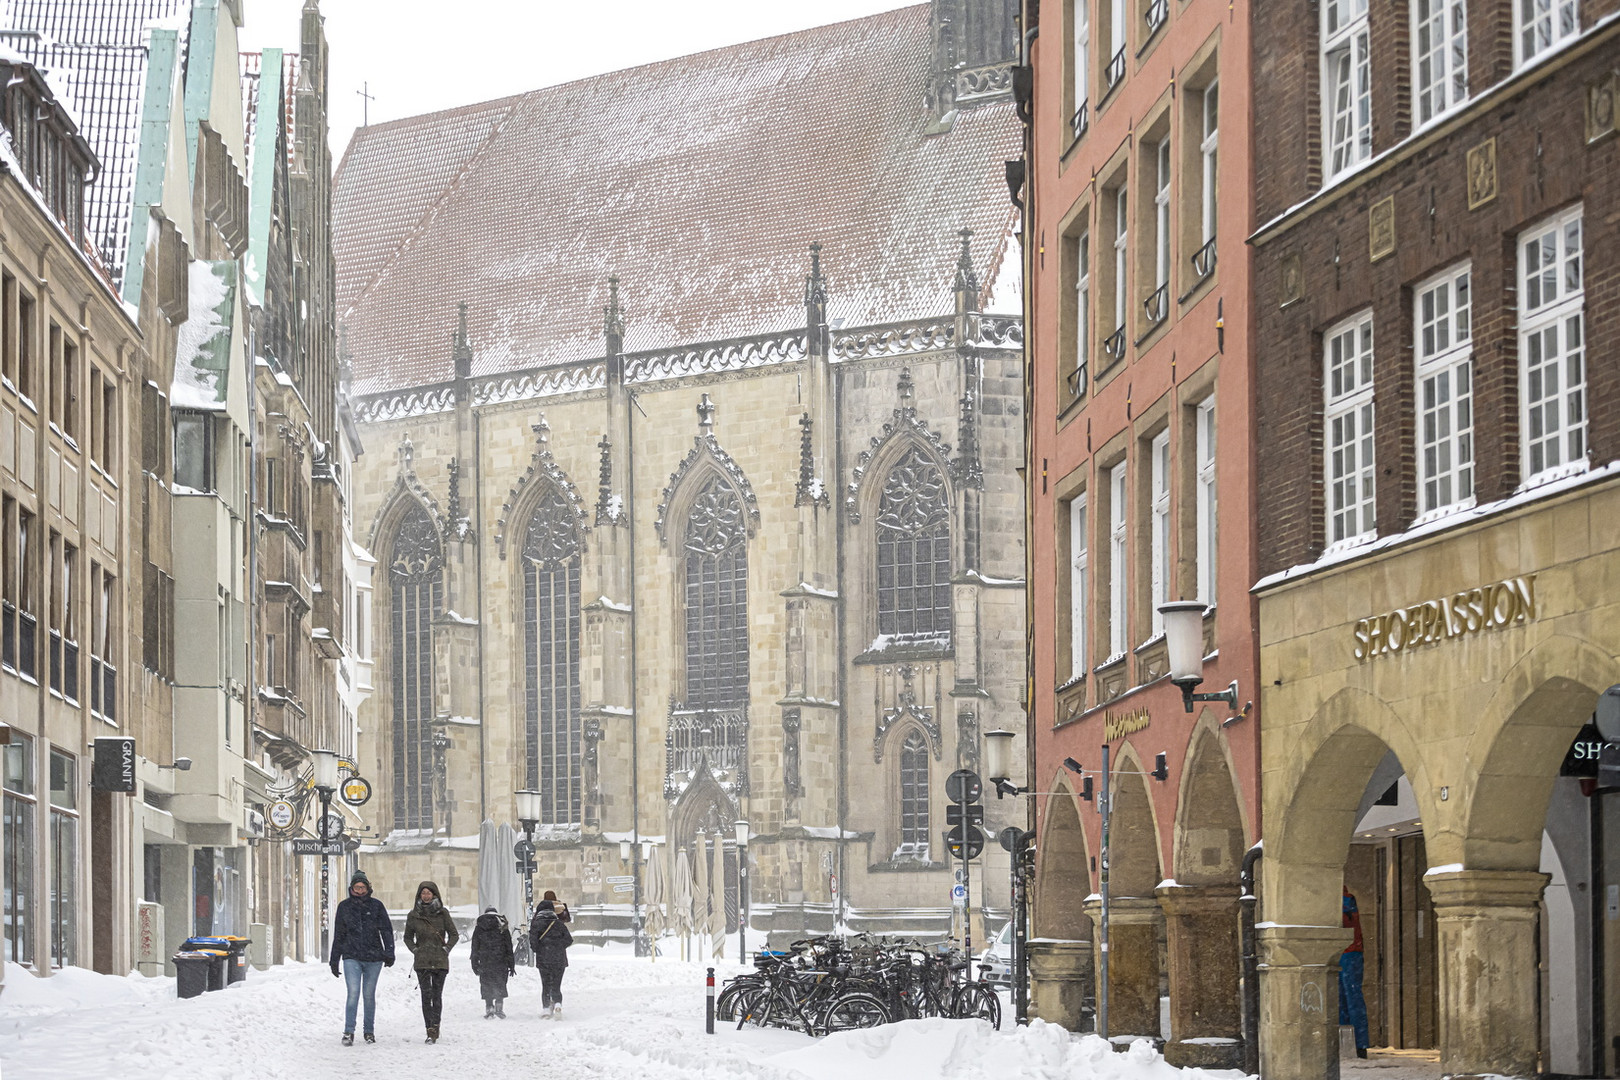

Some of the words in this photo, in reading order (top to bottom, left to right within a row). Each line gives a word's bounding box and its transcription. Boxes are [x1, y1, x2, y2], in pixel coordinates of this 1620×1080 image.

[1353, 575, 1538, 661] SHOEPASSION
[117, 741, 132, 785] GRANIT
[1573, 741, 1618, 760] SH
